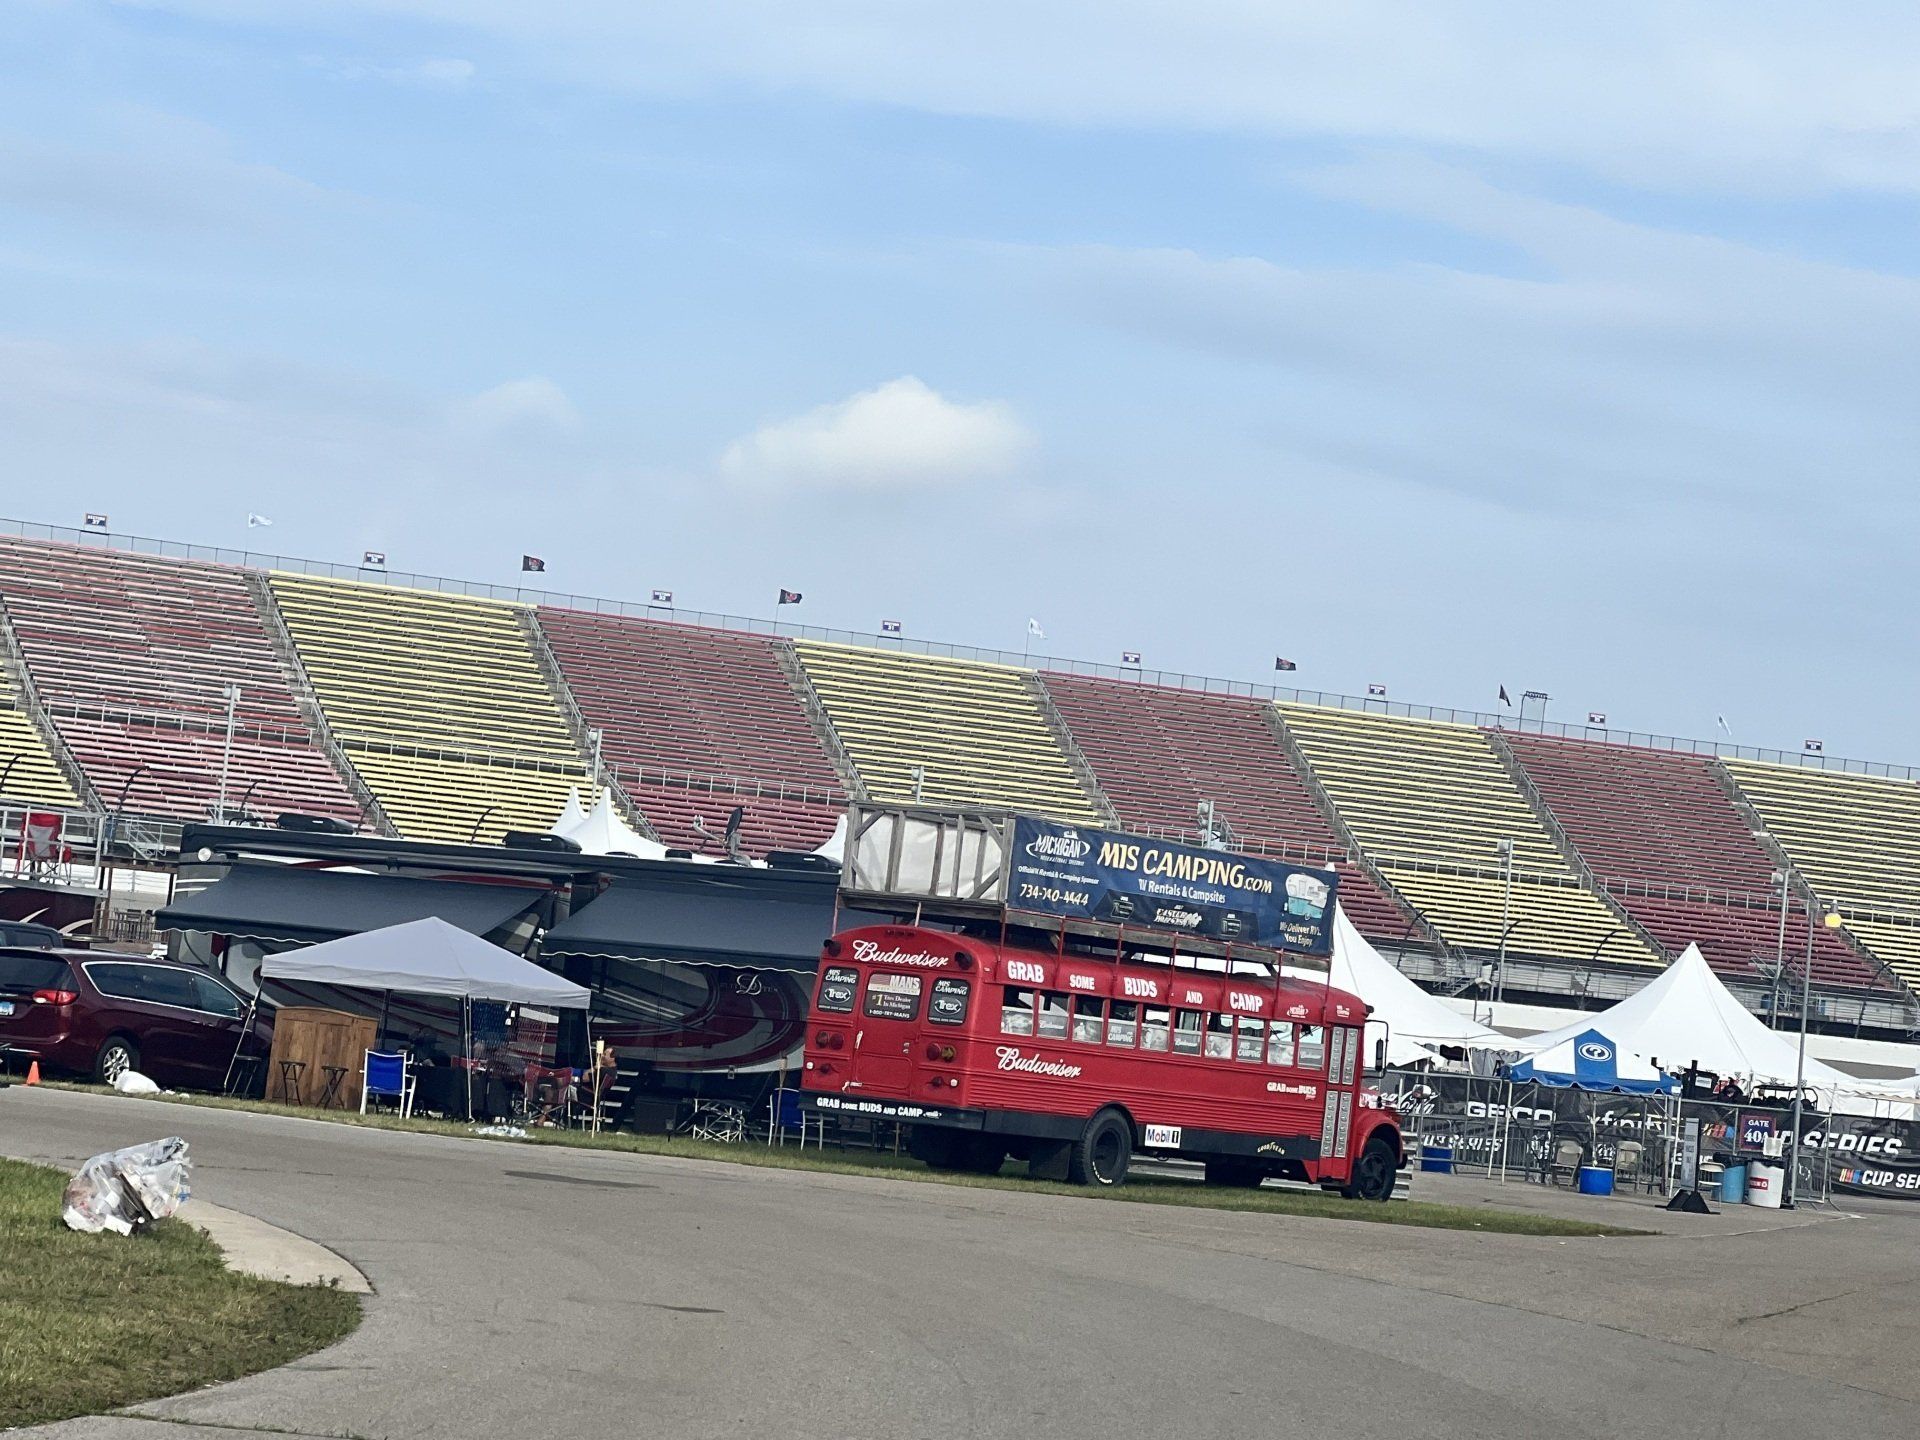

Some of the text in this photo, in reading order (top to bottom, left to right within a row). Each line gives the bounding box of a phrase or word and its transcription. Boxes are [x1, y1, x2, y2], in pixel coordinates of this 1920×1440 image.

[1034, 834, 1081, 858] MICHIGAN
[1097, 841, 1140, 871] MIS
[1148, 880, 1180, 896] Rentals
[1182, 885, 1188, 898] &
[1188, 886, 1226, 904] Campsites
[1284, 933, 1296, 943] You
[852, 939, 949, 968] Budweiser
[825, 974, 856, 984] CAMPING
[889, 975, 920, 989] MANS
[1007, 960, 1263, 1013] GRAB SOME BUDS AND CAMP
[828, 988, 848, 999] Trex
[872, 994, 883, 1006] #1
[938, 999, 959, 1011] Trex
[996, 1046, 1081, 1077] Budweiser
[1266, 1081, 1287, 1092] GRAB
[1298, 1084, 1317, 1095] BUDS
[816, 1097, 840, 1109] GRAB
[858, 1102, 882, 1114] BUDS
[883, 1107, 896, 1115] AND
[897, 1106, 923, 1118] CAMP
[1467, 1101, 1553, 1121] GEICO
[1748, 1119, 1769, 1128] GATE
[1147, 1129, 1180, 1143] Mobil 1
[1802, 1131, 1903, 1156] SERIES
[1861, 1170, 1895, 1187] CUP
